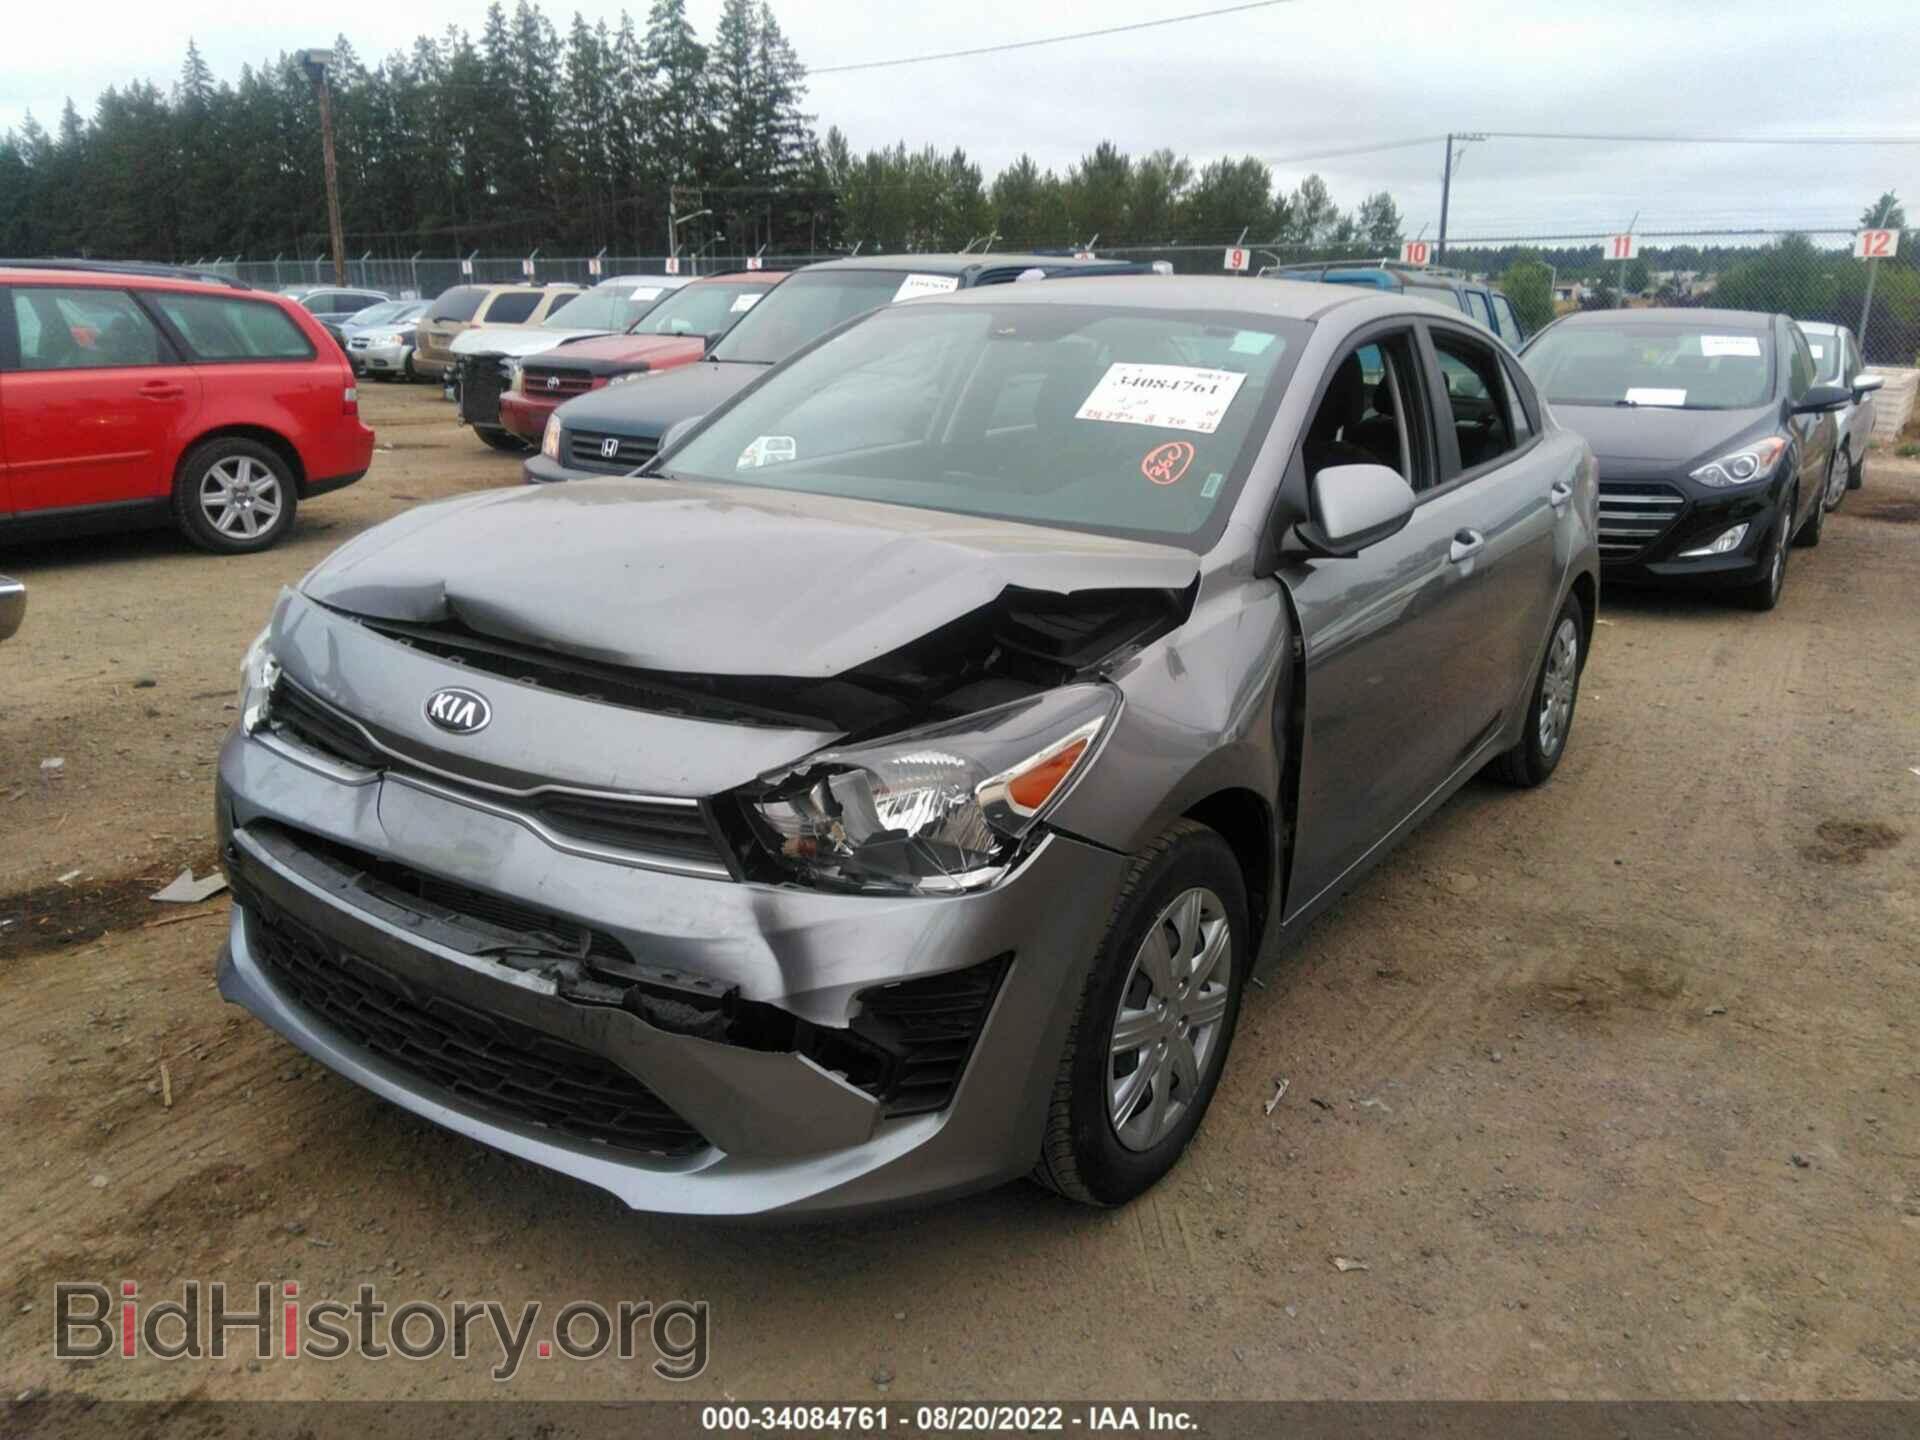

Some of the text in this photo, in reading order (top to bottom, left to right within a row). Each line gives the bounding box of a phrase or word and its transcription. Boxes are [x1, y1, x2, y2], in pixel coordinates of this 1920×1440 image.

[1406, 242, 1425, 263] 10
[1612, 236, 1630, 258] 11
[1862, 230, 1889, 256] 12
[1232, 250, 1243, 268] 9
[429, 692, 477, 728] KIA
